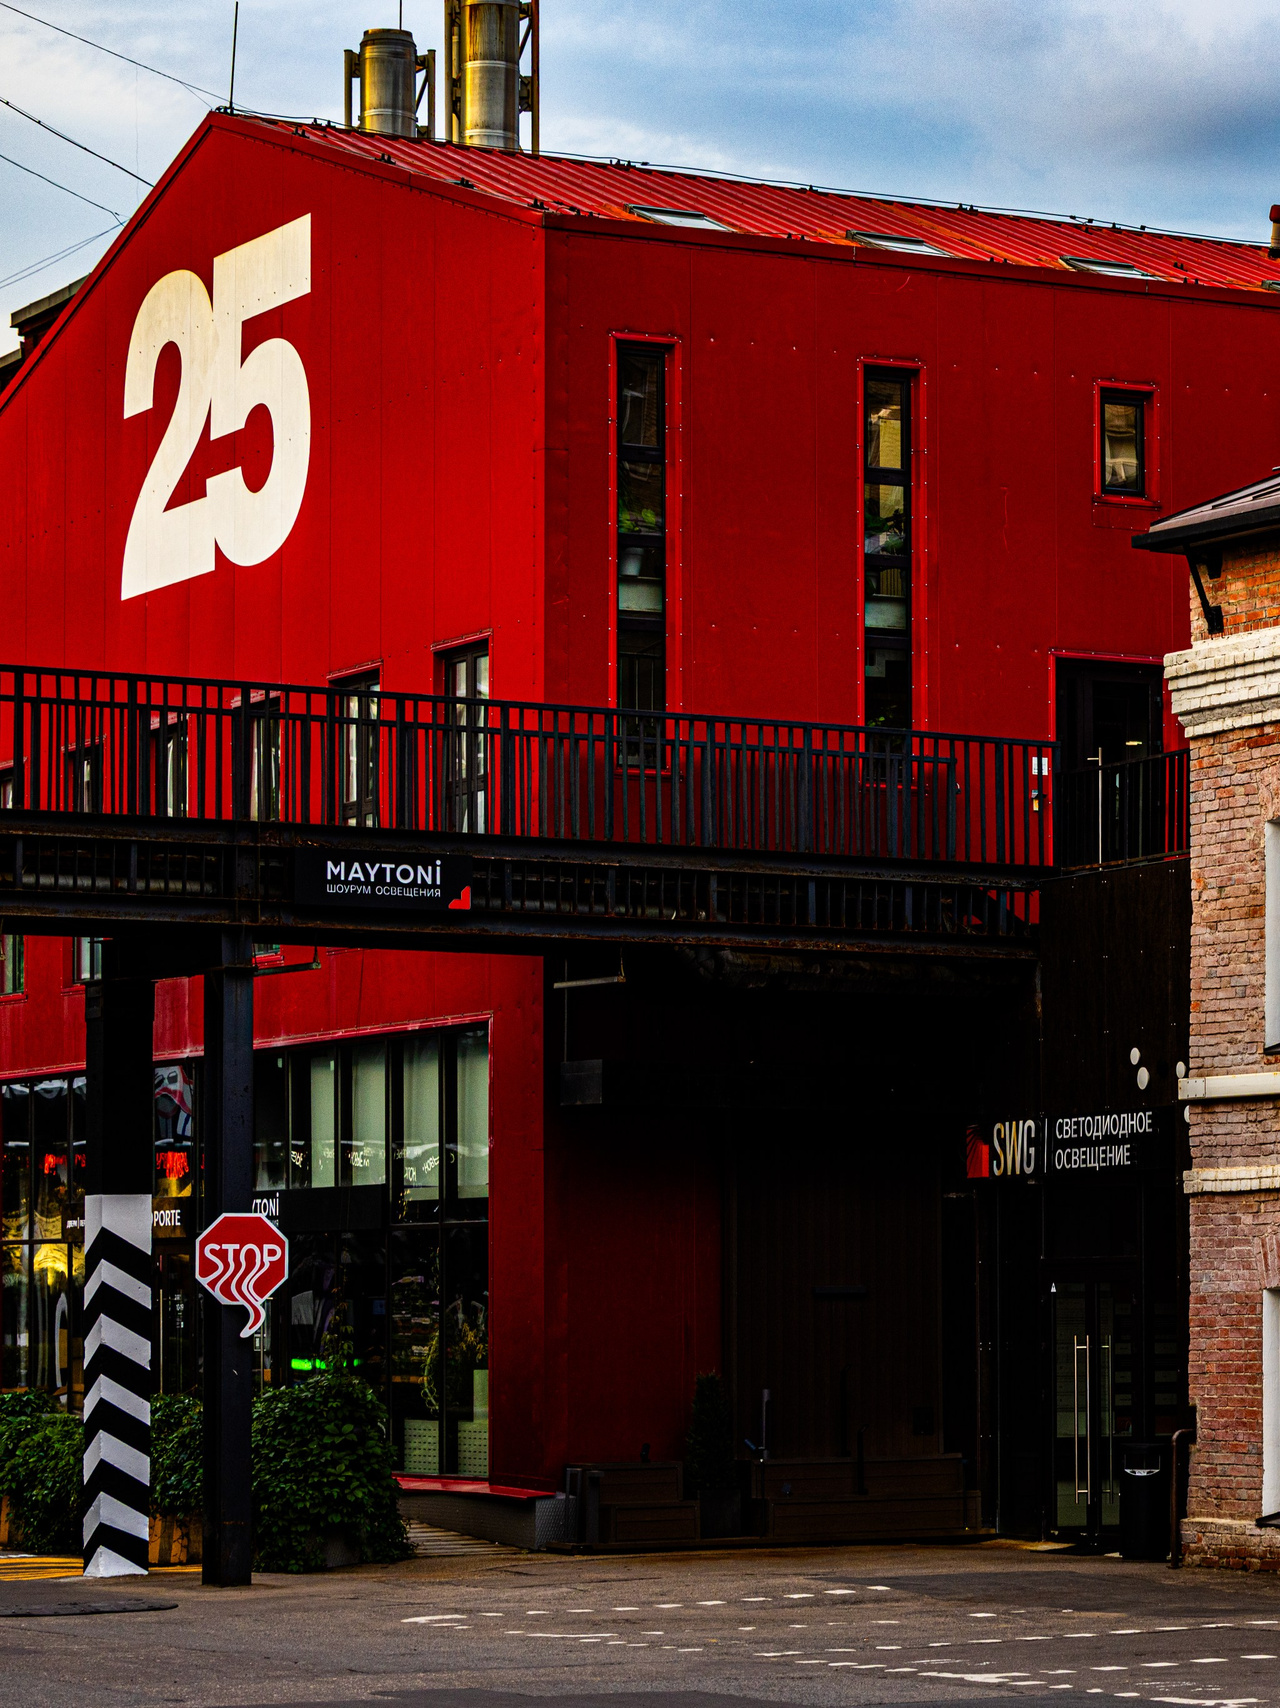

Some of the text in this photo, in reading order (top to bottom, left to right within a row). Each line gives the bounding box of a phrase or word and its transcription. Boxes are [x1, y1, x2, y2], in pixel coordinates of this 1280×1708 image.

[121, 213, 311, 600] 25
[326, 884, 441, 898] ШОУРУМ ОСВЕЩЕНИЯ
[1055, 1111, 1153, 1141] СВЕТОДИОДНОЕ
[993, 1119, 1036, 1177] SWG
[1055, 1144, 1131, 1171] ОСВЕЩЕНИЕ
